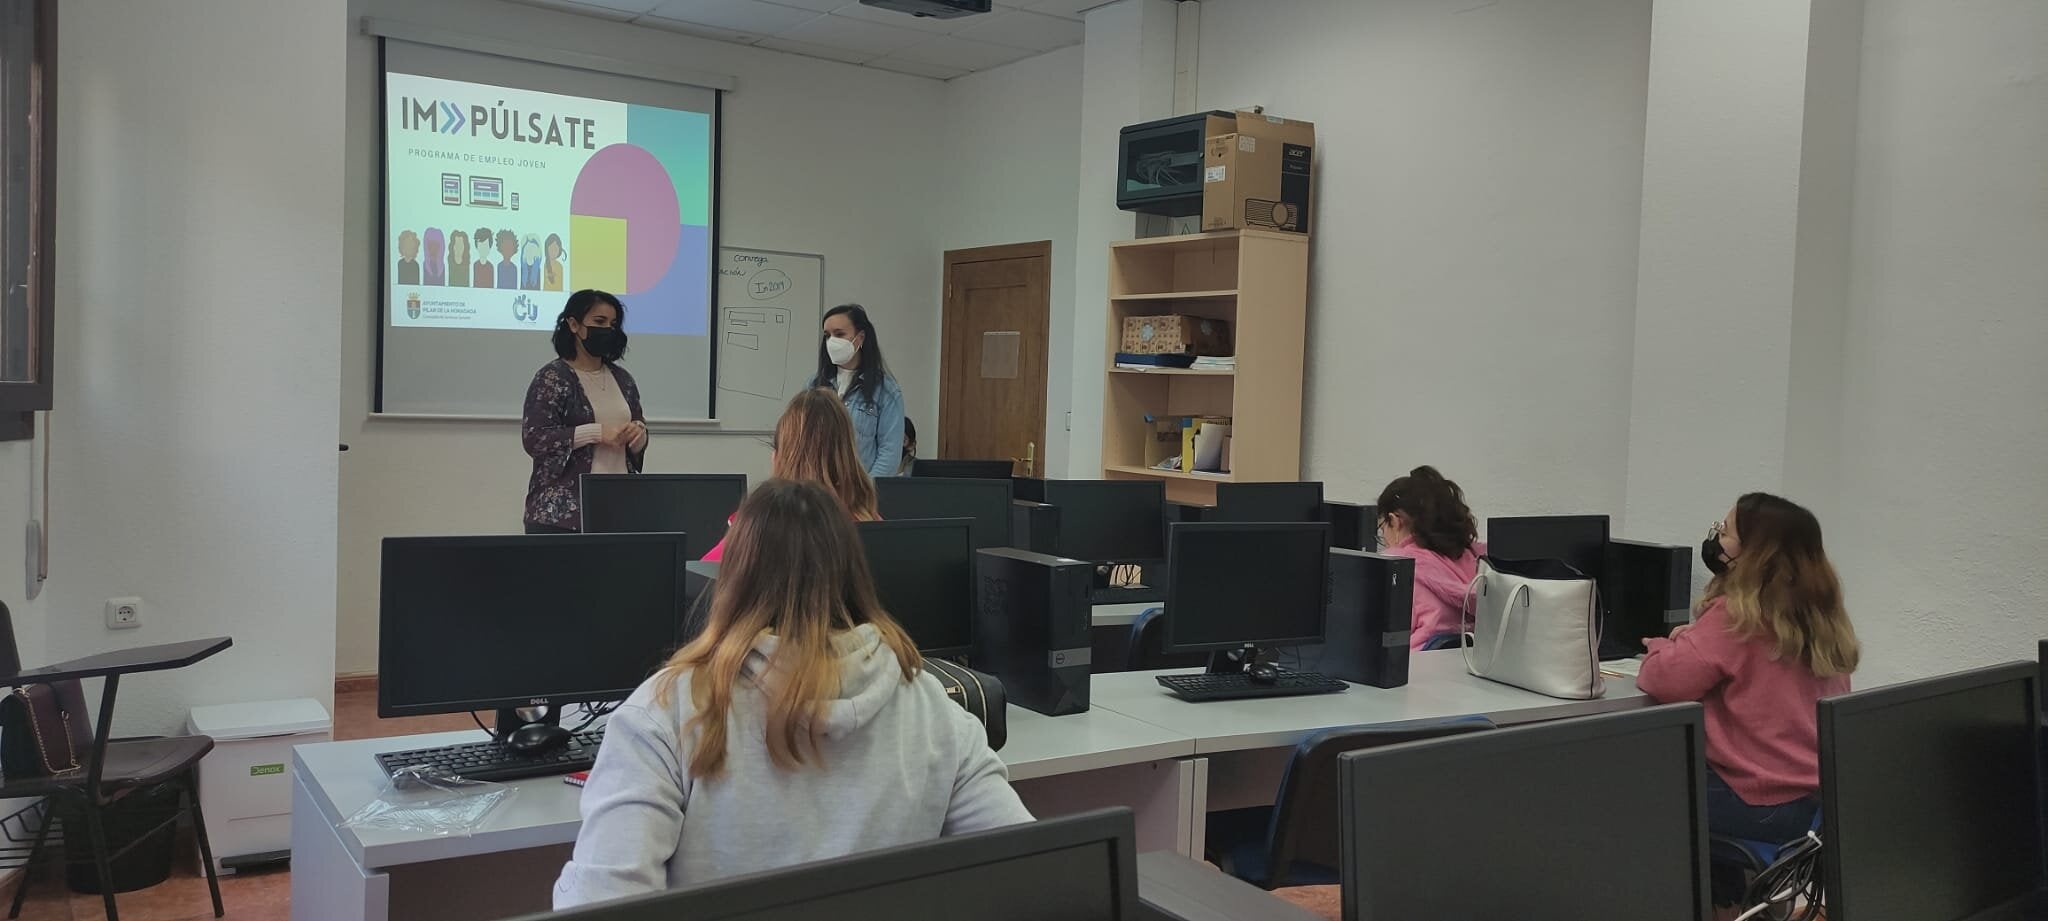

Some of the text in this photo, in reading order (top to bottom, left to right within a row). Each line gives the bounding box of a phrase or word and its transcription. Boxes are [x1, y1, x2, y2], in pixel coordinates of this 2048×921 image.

[471, 100, 596, 150] PÚLSATE
[408, 148, 546, 169] PROGRAMA DE EMPLEO JOVEN
